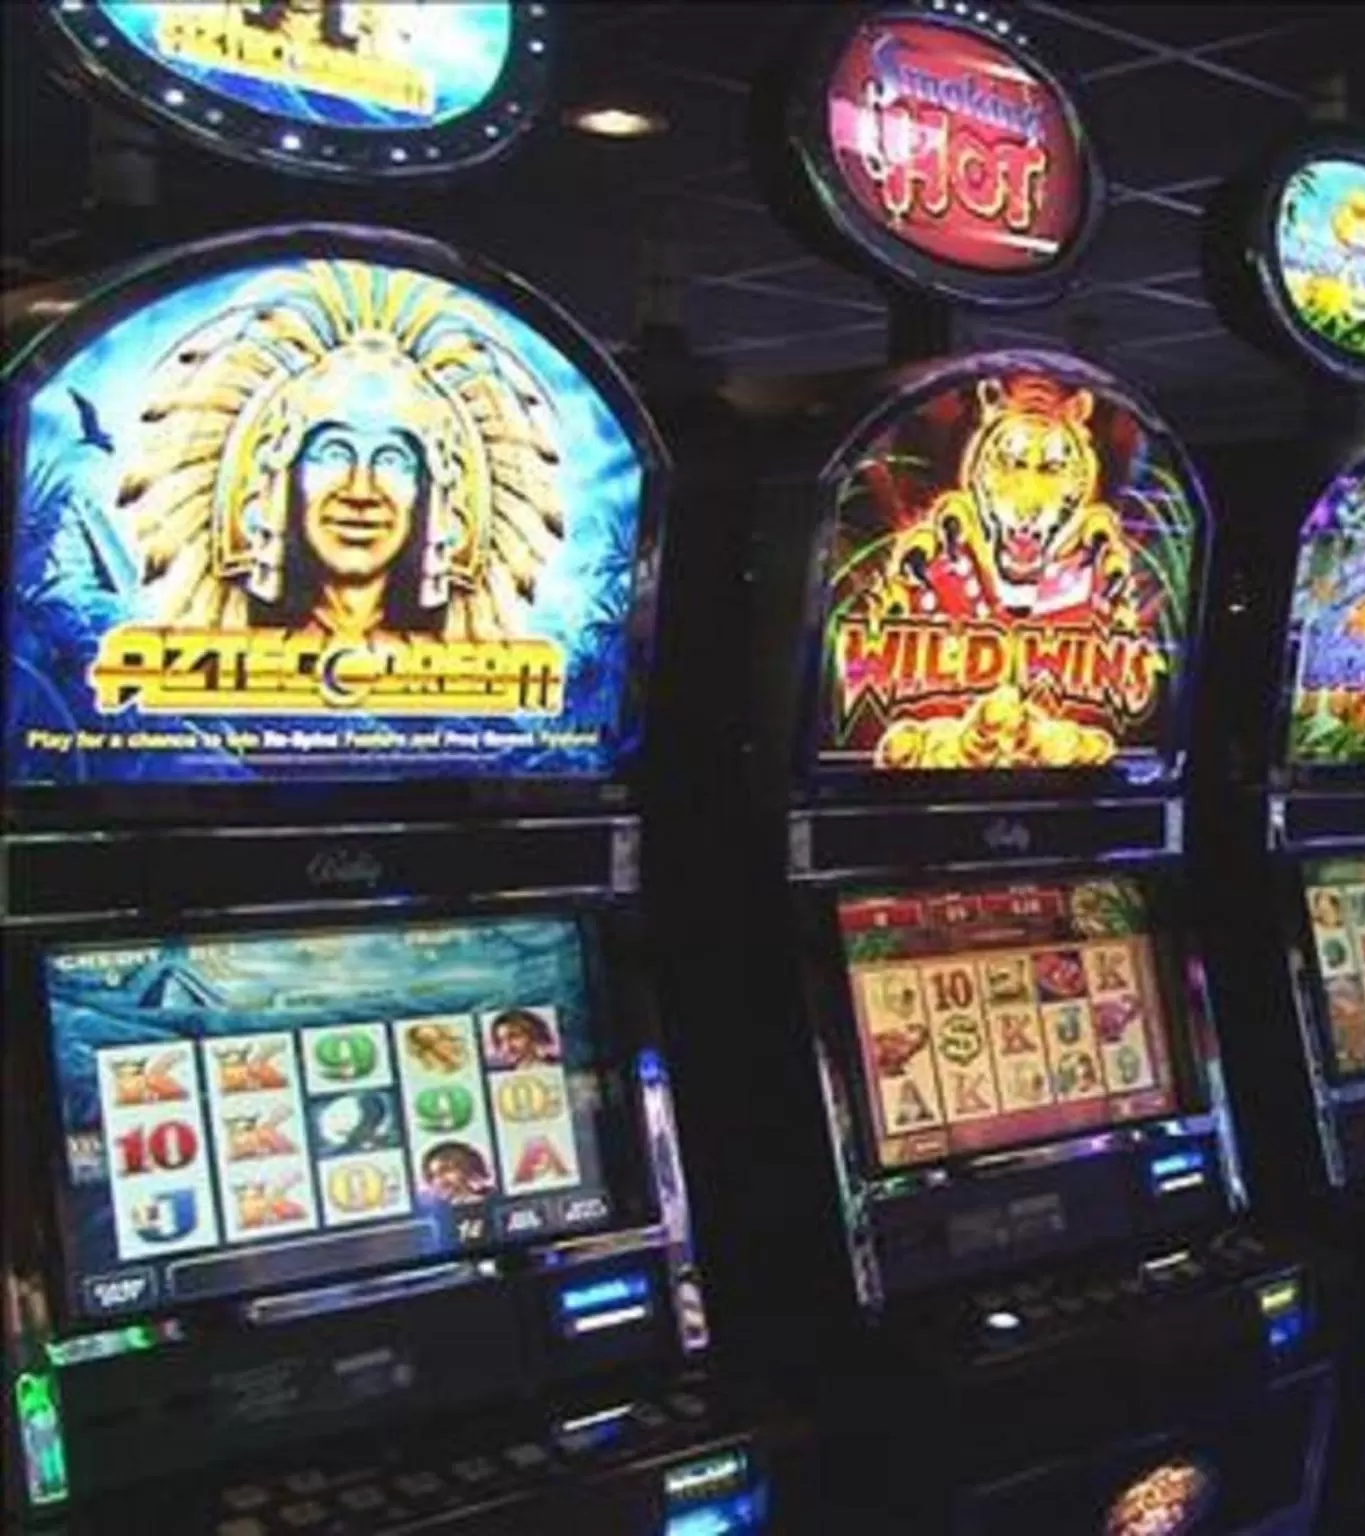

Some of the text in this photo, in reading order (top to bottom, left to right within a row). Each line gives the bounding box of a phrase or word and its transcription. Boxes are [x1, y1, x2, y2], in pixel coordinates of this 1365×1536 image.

[878, 103, 1047, 229] HOT
[840, 621, 1162, 712] WILD WINS
[27, 731, 71, 752] Play
[76, 731, 104, 749] for
[126, 732, 197, 749] chance
[931, 968, 974, 1012] 10
[315, 1028, 378, 1081] 9
[997, 1012, 1038, 1056] K
[895, 1079, 935, 1127] A
[955, 1071, 991, 1115] K
[114, 1122, 198, 1178] 10
[415, 1084, 474, 1133] 9
[131, 1188, 198, 1244] J
